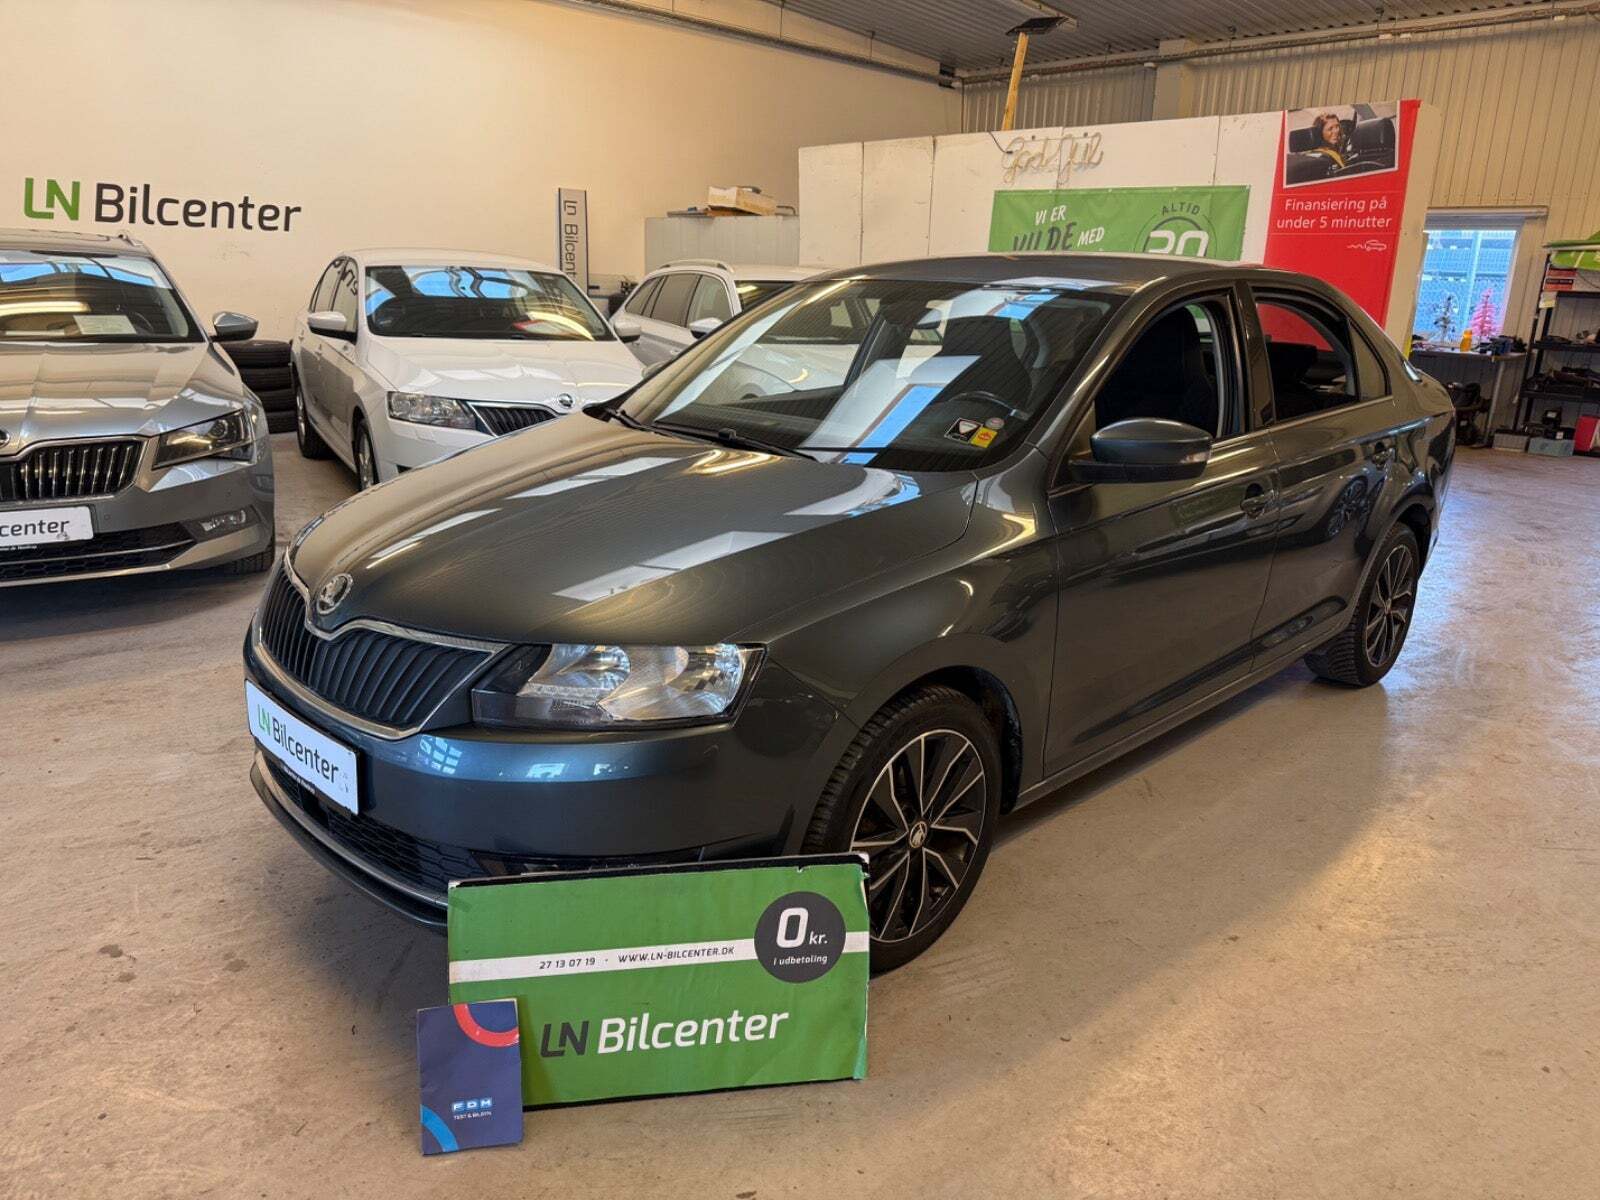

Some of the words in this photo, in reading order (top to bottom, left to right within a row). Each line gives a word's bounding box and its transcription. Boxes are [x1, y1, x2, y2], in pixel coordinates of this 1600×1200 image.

[24, 177, 80, 221] LN
[94, 183, 302, 232] Bilcenter
[1162, 202, 1201, 216] ALTID
[1285, 197, 1366, 213] Finansiering
[1369, 195, 1387, 212] på
[1035, 209, 1047, 226] VI
[1051, 205, 1067, 222] ER
[1277, 215, 1315, 229] under
[1320, 215, 1328, 229] 5
[1331, 215, 1392, 229] minutter
[1077, 227, 1105, 248] MED
[257, 704, 271, 736] LN
[272, 716, 339, 783] Bilcenter
[776, 907, 809, 948] 0
[809, 931, 828, 945] kr.
[539, 961, 552, 969] 27
[555, 959, 565, 968] 13
[569, 958, 582, 967] 07
[585, 957, 596, 966] 19
[618, 946, 735, 963] WWW.LN-BILCENTER.DK
[779, 955, 828, 966] udbetaling
[540, 1020, 589, 1058] LN
[598, 1010, 789, 1054] Bilcenter
